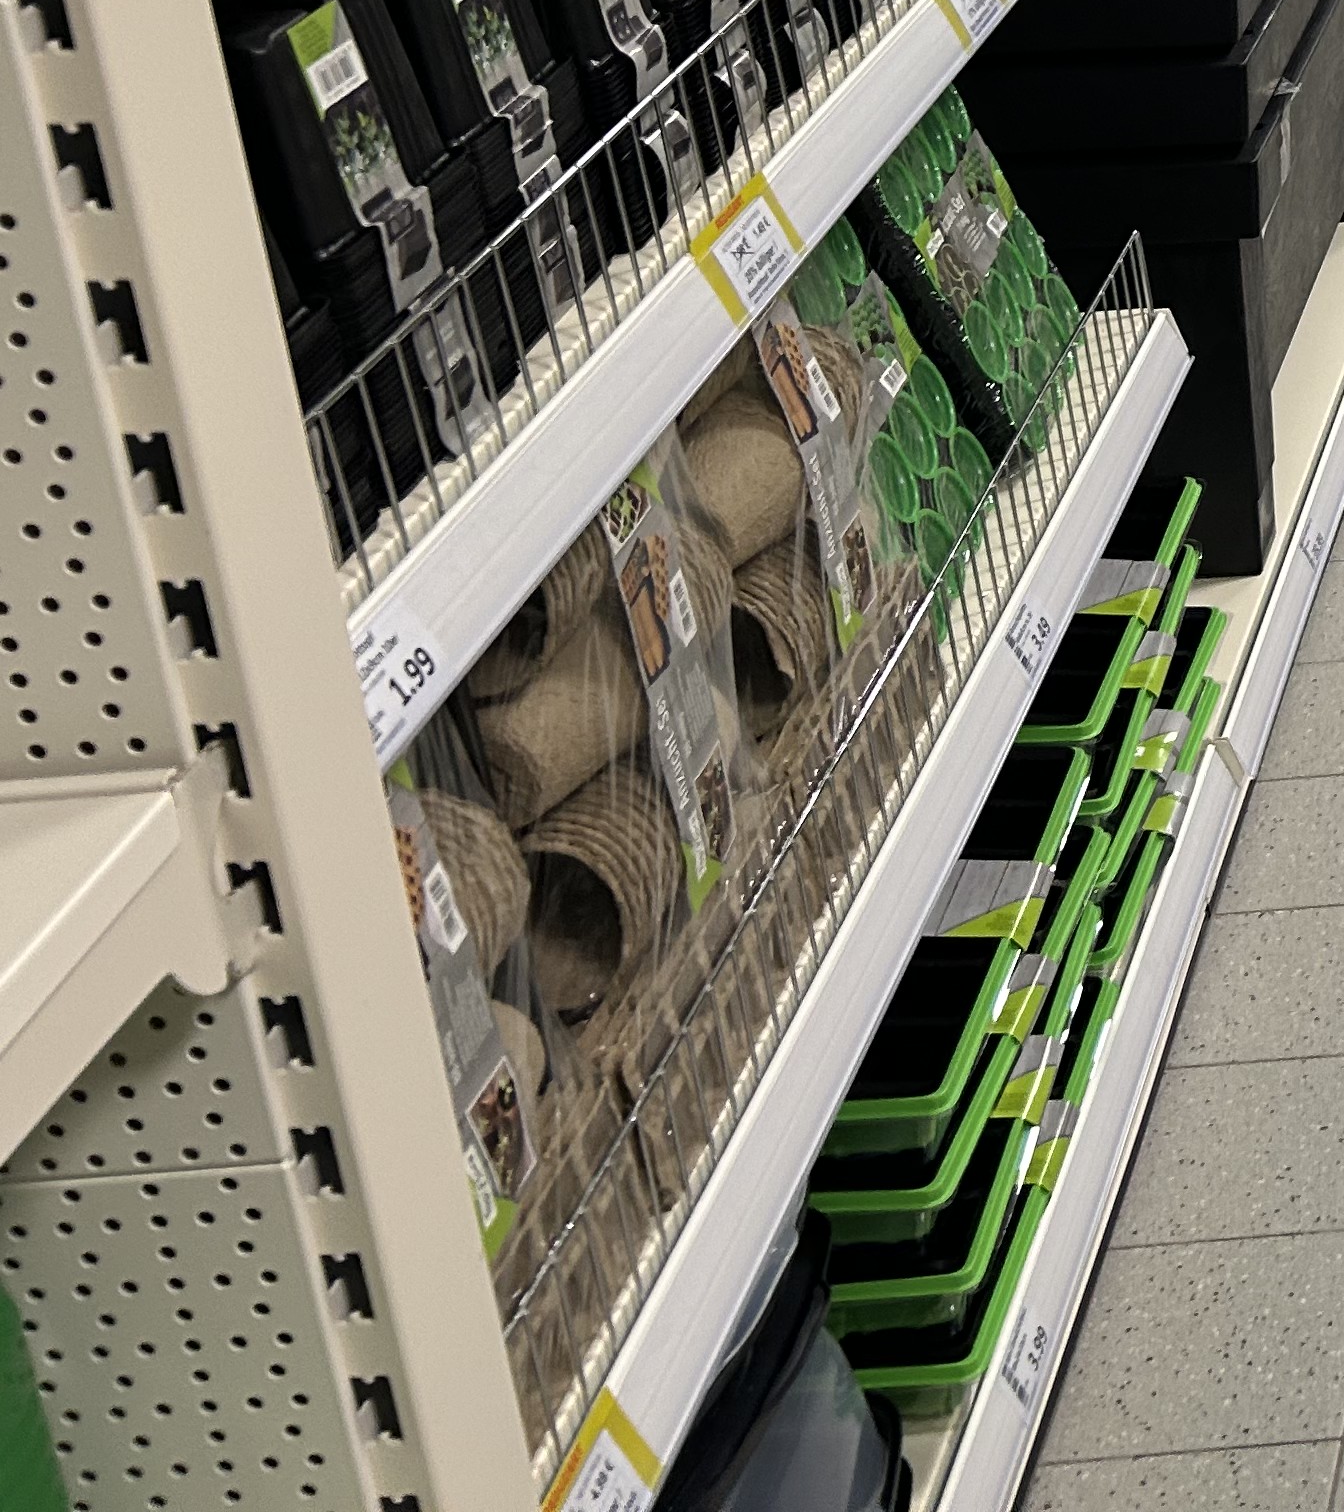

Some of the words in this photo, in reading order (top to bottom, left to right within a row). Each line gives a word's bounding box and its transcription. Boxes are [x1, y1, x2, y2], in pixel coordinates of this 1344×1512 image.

[1032, 617, 1051, 652] 3.49
[389, 646, 436, 707] 1.99
[656, 697, 690, 810] Anzucht-Set
[1028, 1324, 1048, 1373] 3.99
